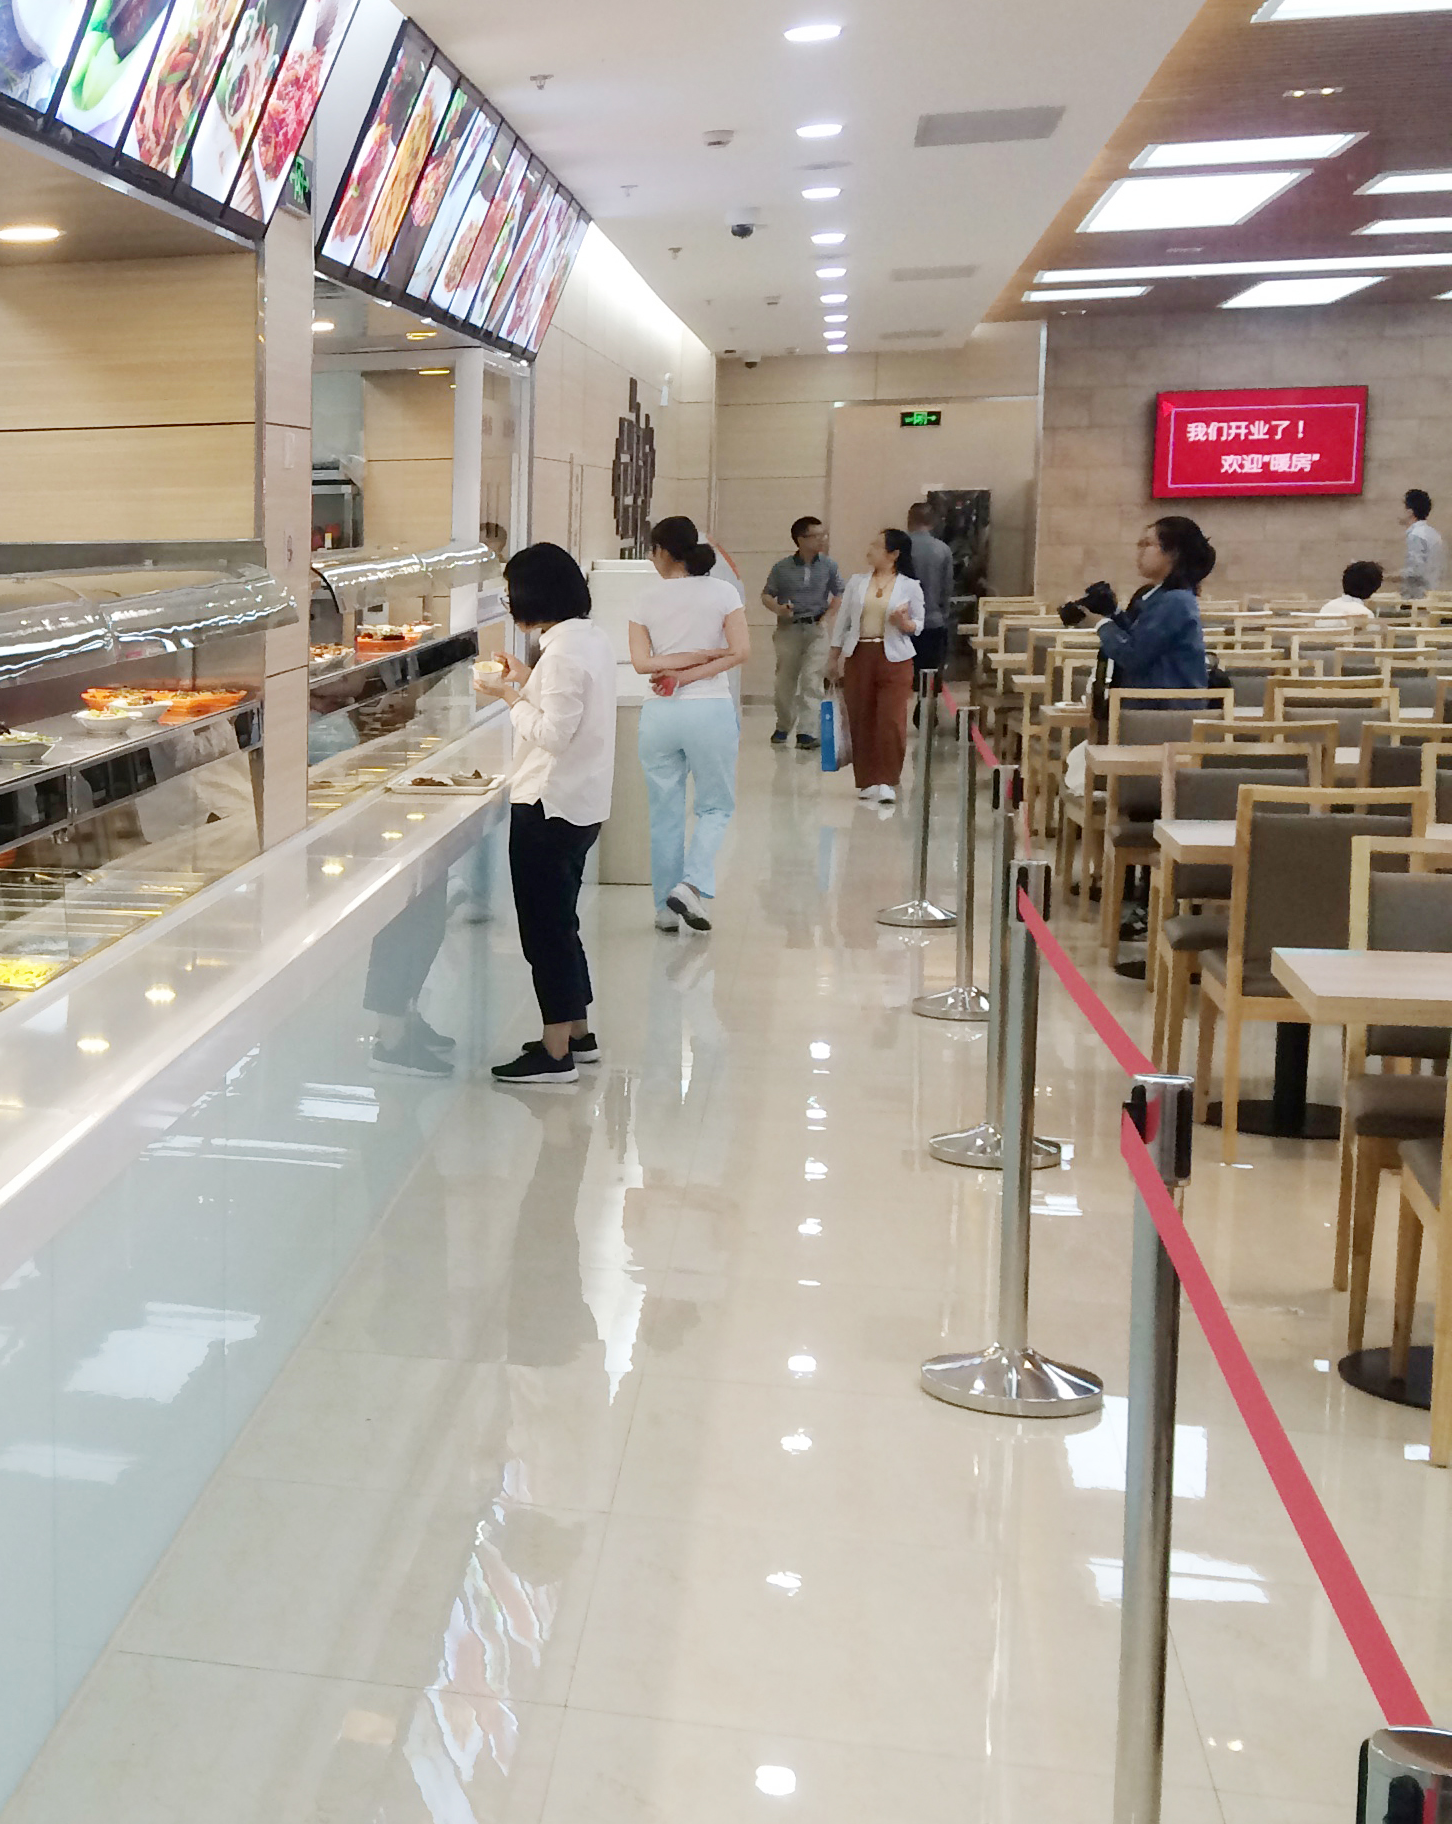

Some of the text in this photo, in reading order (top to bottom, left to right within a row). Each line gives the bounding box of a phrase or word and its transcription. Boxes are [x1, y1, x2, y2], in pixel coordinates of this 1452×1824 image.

[1186, 420, 1305, 442] 我们开业了！
